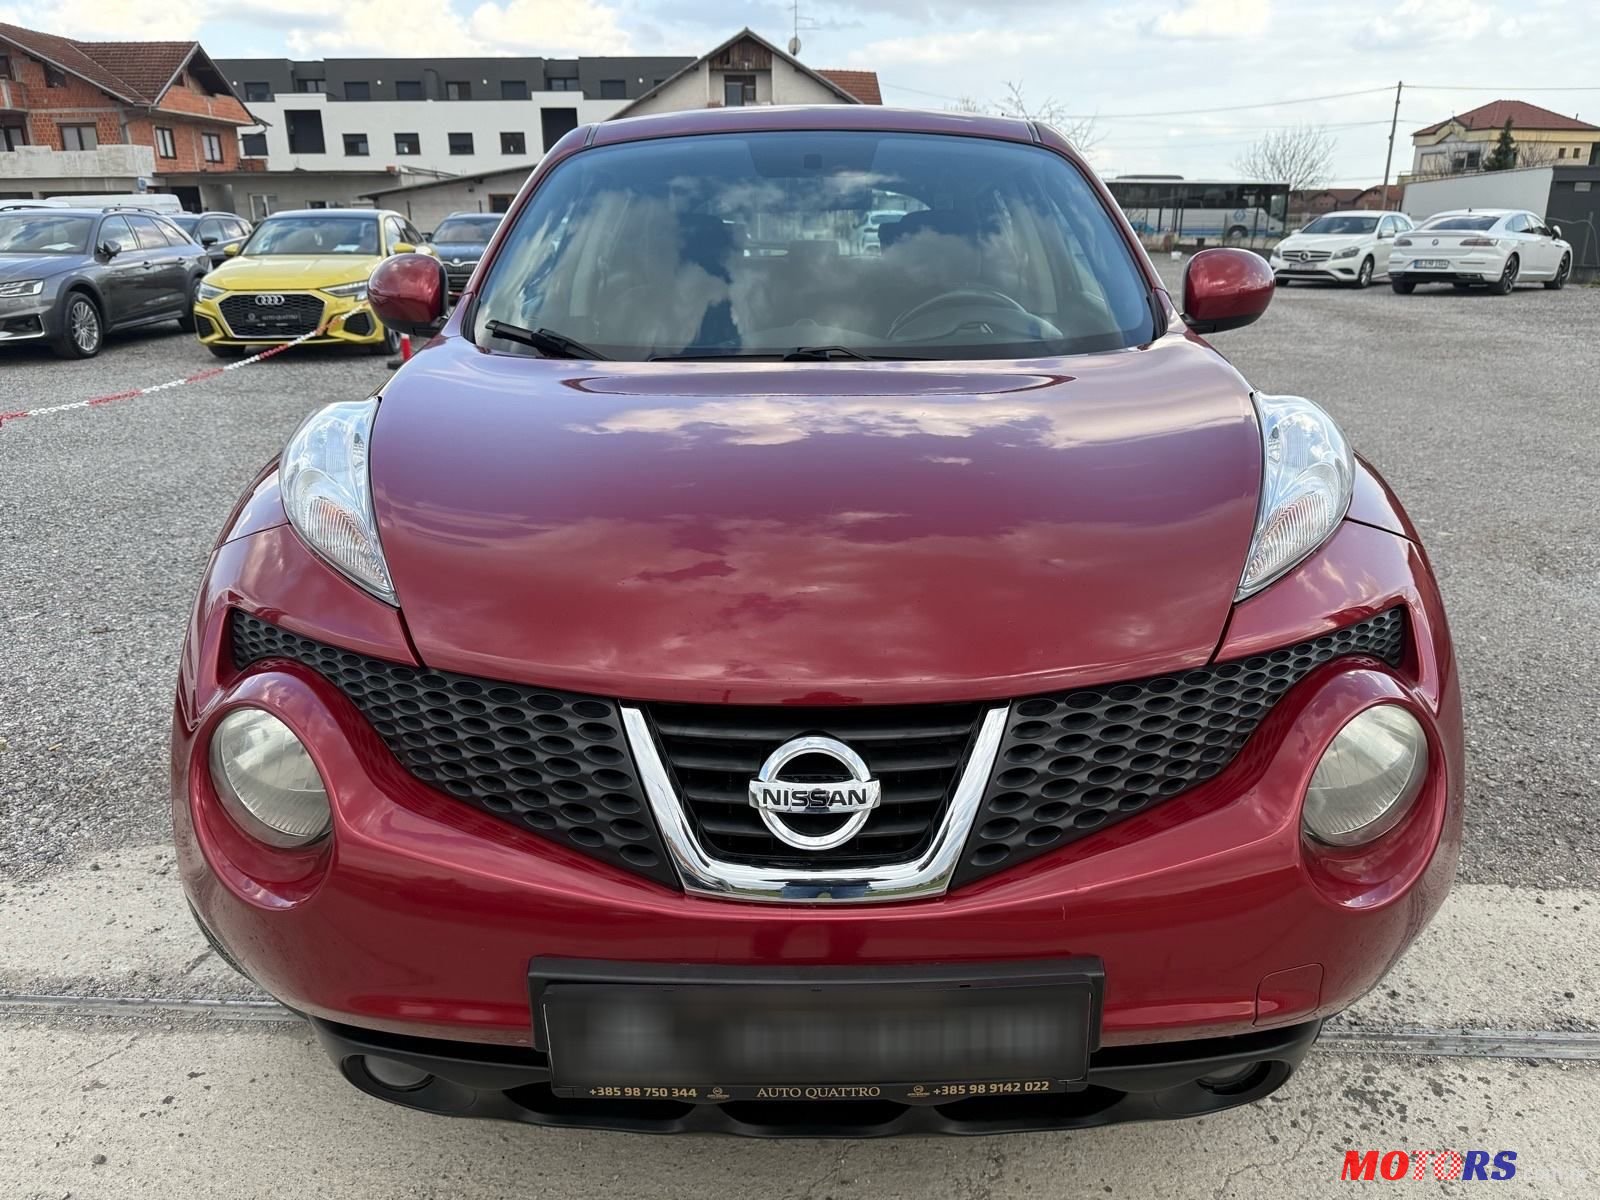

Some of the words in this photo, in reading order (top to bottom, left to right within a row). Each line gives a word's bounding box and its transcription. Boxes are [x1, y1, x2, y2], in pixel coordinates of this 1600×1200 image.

[762, 788, 867, 807] NISSAN
[589, 1086, 621, 1097] +385
[624, 1087, 641, 1097] 98
[643, 1087, 668, 1097] 750
[671, 1088, 697, 1098] 344
[756, 1087, 801, 1098] AUTO
[805, 1086, 880, 1099] QUATTRO
[933, 1085, 966, 1096] +385
[969, 1084, 986, 1094] 98
[989, 1083, 1021, 1093] 9142
[1024, 1081, 1049, 1092] 022
